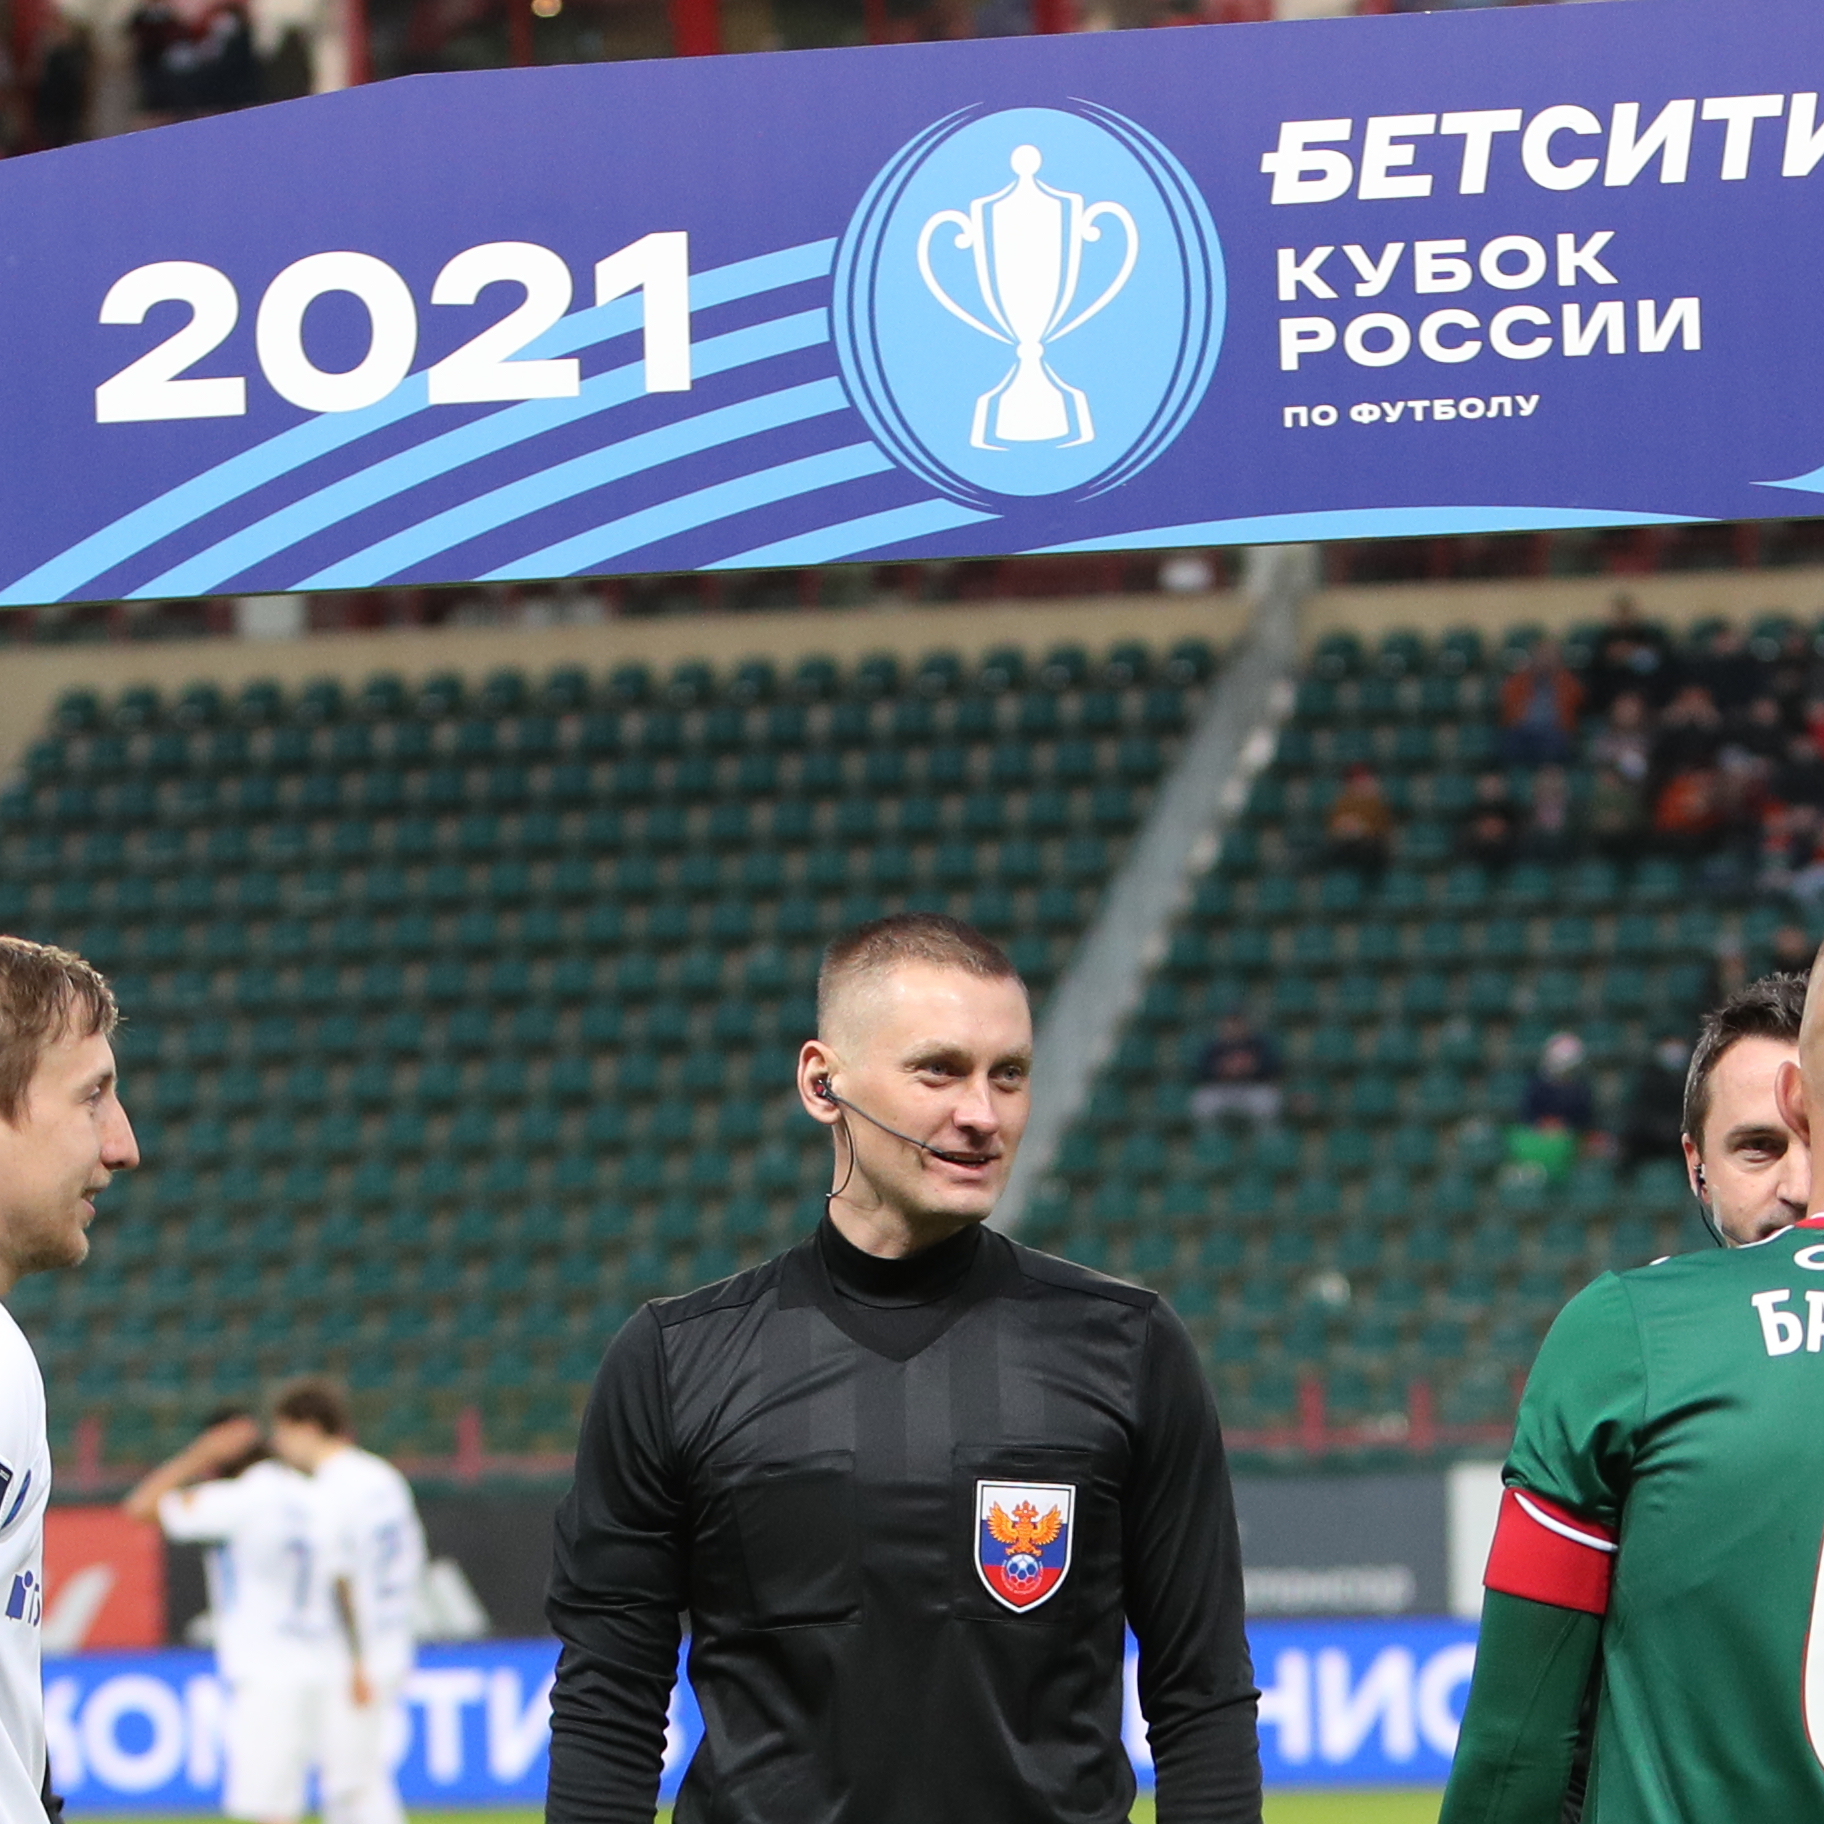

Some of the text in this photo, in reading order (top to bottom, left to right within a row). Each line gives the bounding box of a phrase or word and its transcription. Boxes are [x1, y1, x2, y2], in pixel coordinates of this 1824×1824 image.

[1277, 231, 1619, 301] КУБОК
[94, 230, 692, 424] 2021
[1279, 297, 1702, 371] РОССИИ
[1283, 394, 1540, 428] ПО ФУТБОЛУ
